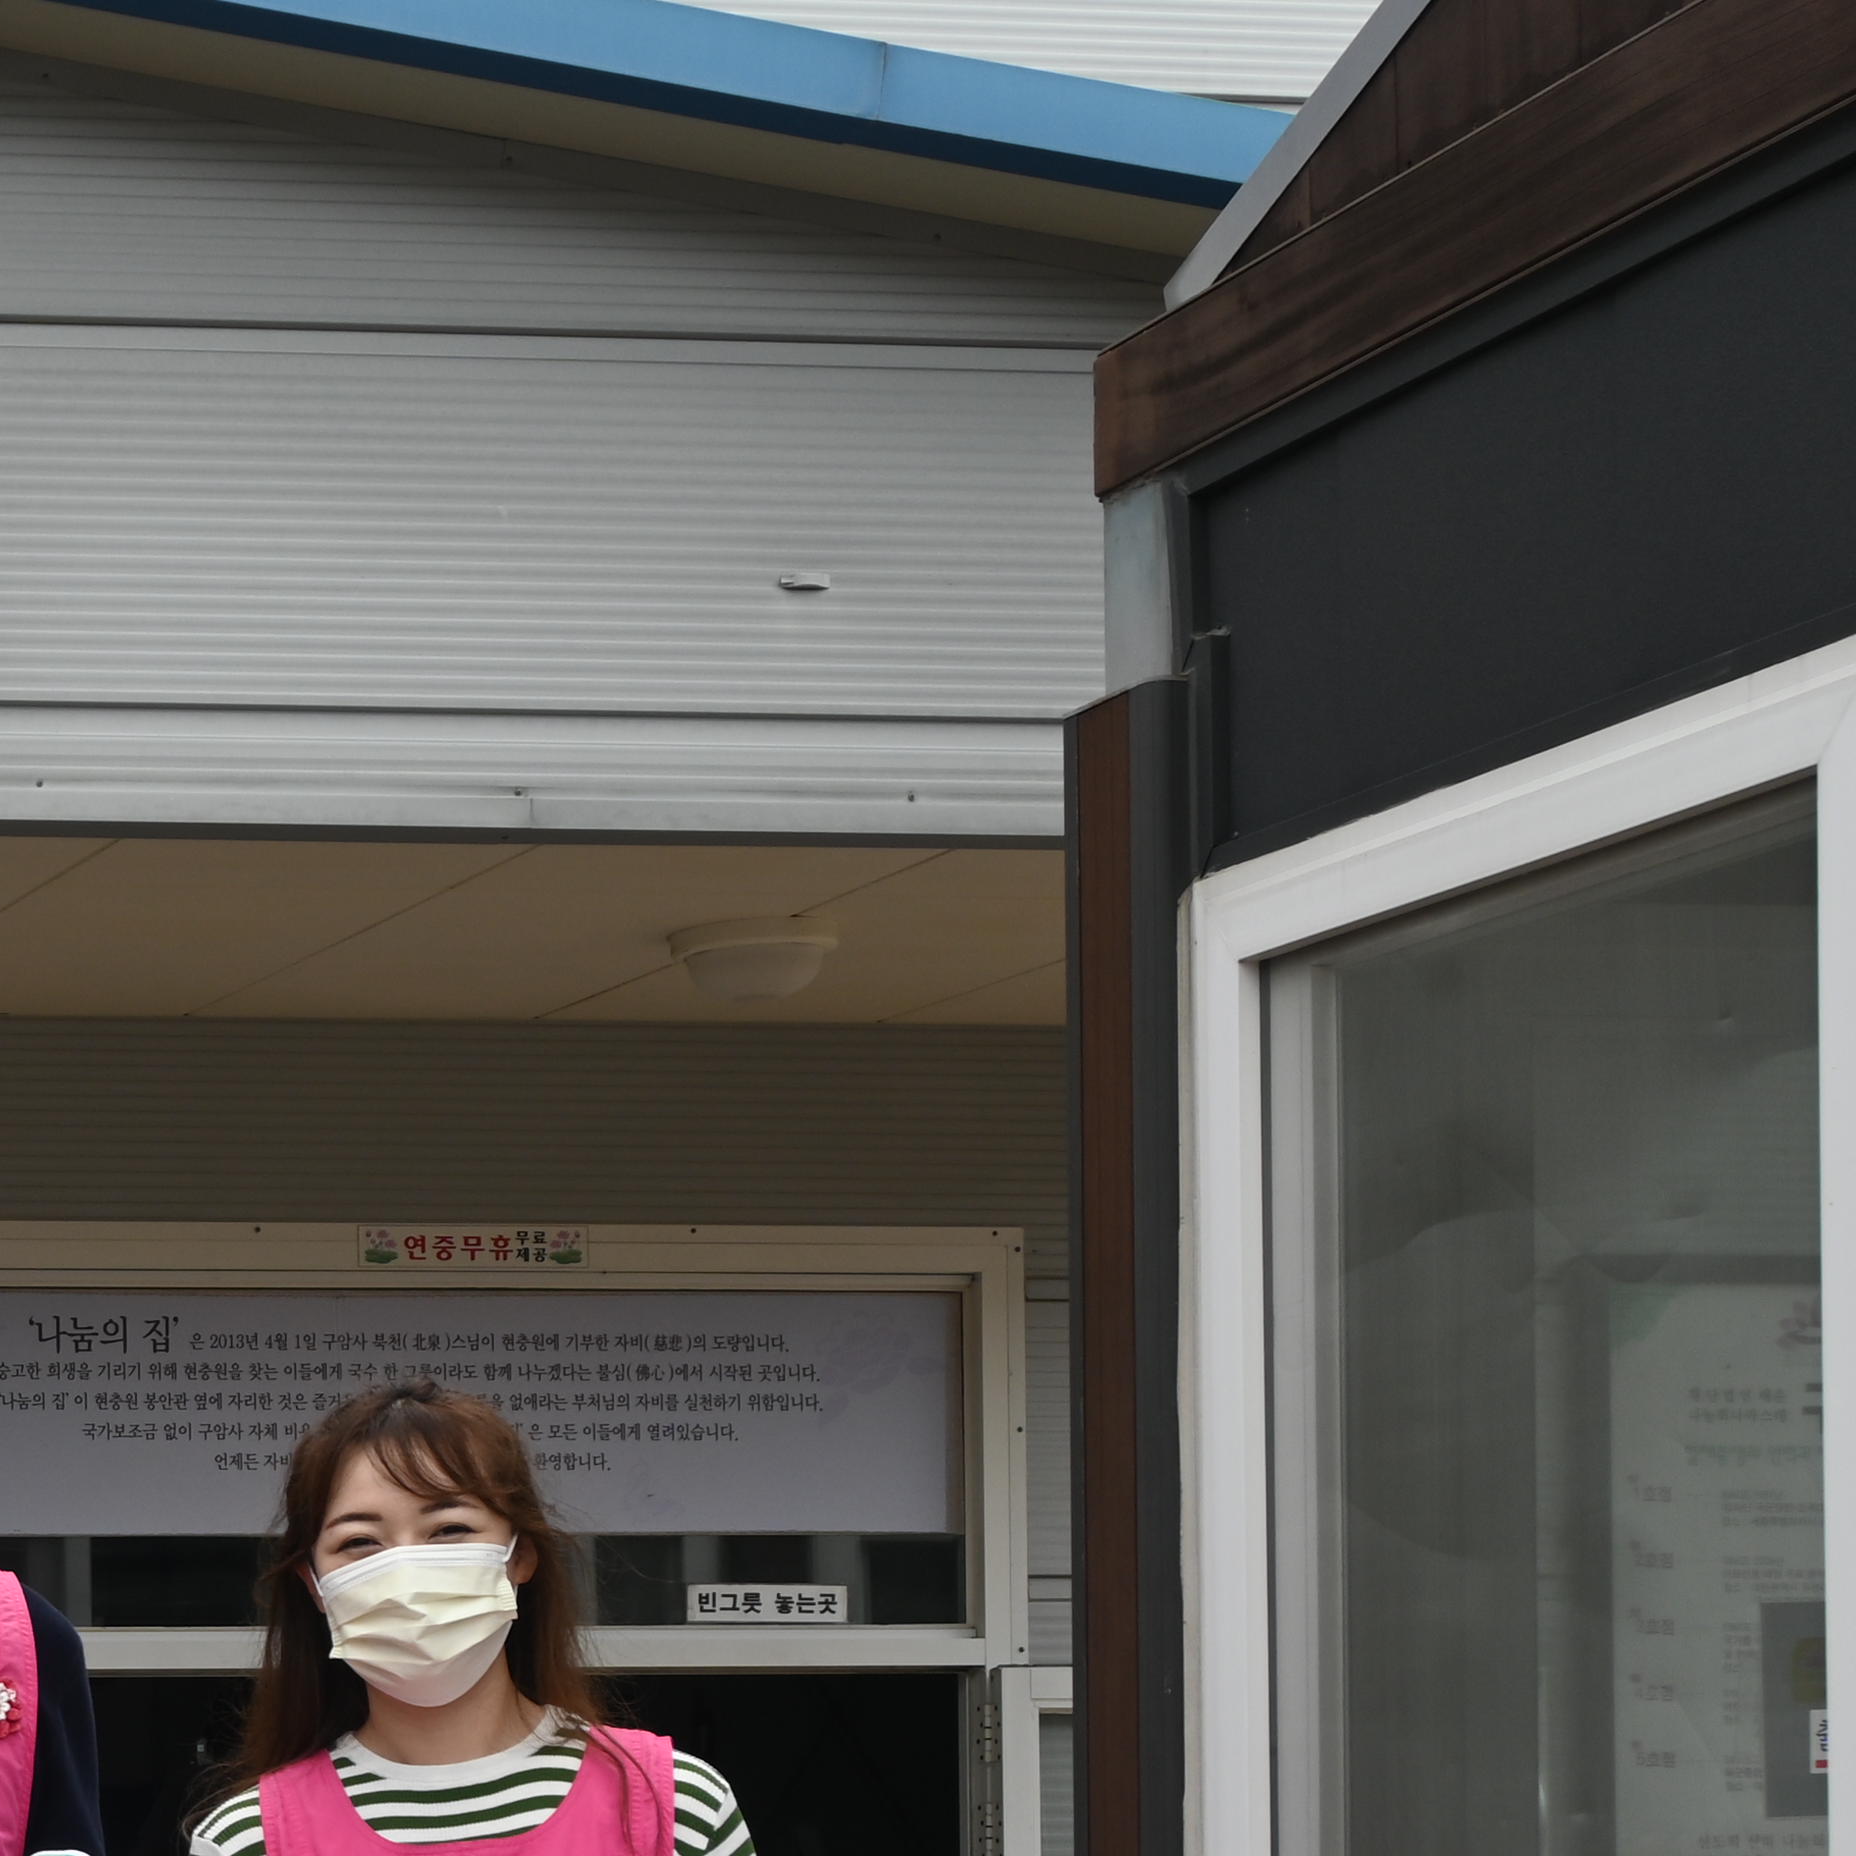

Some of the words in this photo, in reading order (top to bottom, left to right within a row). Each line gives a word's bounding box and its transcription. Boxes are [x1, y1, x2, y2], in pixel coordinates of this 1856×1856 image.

[403, 1234, 514, 1261] 연중무휴
[189, 1333, 205, 1351] 은
[209, 1332, 259, 1351] 2013년
[264, 1332, 288, 1351] 4월
[295, 1332, 317, 1351] 1일
[322, 1332, 368, 1351] 구암사
[502, 1333, 560, 1352] 현충원에
[566, 1333, 610, 1352] 기부한
[712, 1334, 789, 1353] 도량입니다.
[46, 1362, 93, 1381] 희생을
[97, 1362, 141, 1381] 기리기
[147, 1362, 177, 1381] 위해
[183, 1362, 243, 1381] 현충원을
[249, 1362, 278, 1381] 찾는
[283, 1362, 343, 1381] 이들에게
[348, 1362, 377, 1381] 국수
[383, 1362, 397, 1381] 한
[483, 1363, 512, 1381] 함께
[517, 1363, 592, 1382] 나누겠다는
[709, 1363, 753, 1382] 시작된
[757, 1363, 821, 1382] 곳입니다.
[94, 1391, 139, 1411] 현충원
[143, 1391, 190, 1411] 봉안관
[193, 1391, 223, 1411] 옆에
[227, 1391, 274, 1411] 자리한
[278, 1392, 308, 1411] 것은
[509, 1392, 569, 1411] 없애라는
[571, 1392, 630, 1412] 부처님의
[636, 1392, 679, 1412] 자비를
[684, 1393, 741, 1412] 실천하기
[747, 1393, 823, 1412] 위함입니다.
[81, 1422, 159, 1441] 국가보조금
[163, 1422, 192, 1441] 없이
[198, 1422, 245, 1441] 구암사
[248, 1422, 278, 1441] 자체
[527, 1423, 543, 1441] 은
[547, 1423, 578, 1441] 모든
[582, 1422, 641, 1441] 이들에게
[647, 1422, 739, 1442] 열려있습니다.
[214, 1452, 260, 1471] 언제든
[697, 1592, 762, 1614] 빈그릇
[774, 1592, 838, 1615] 놓는곳
